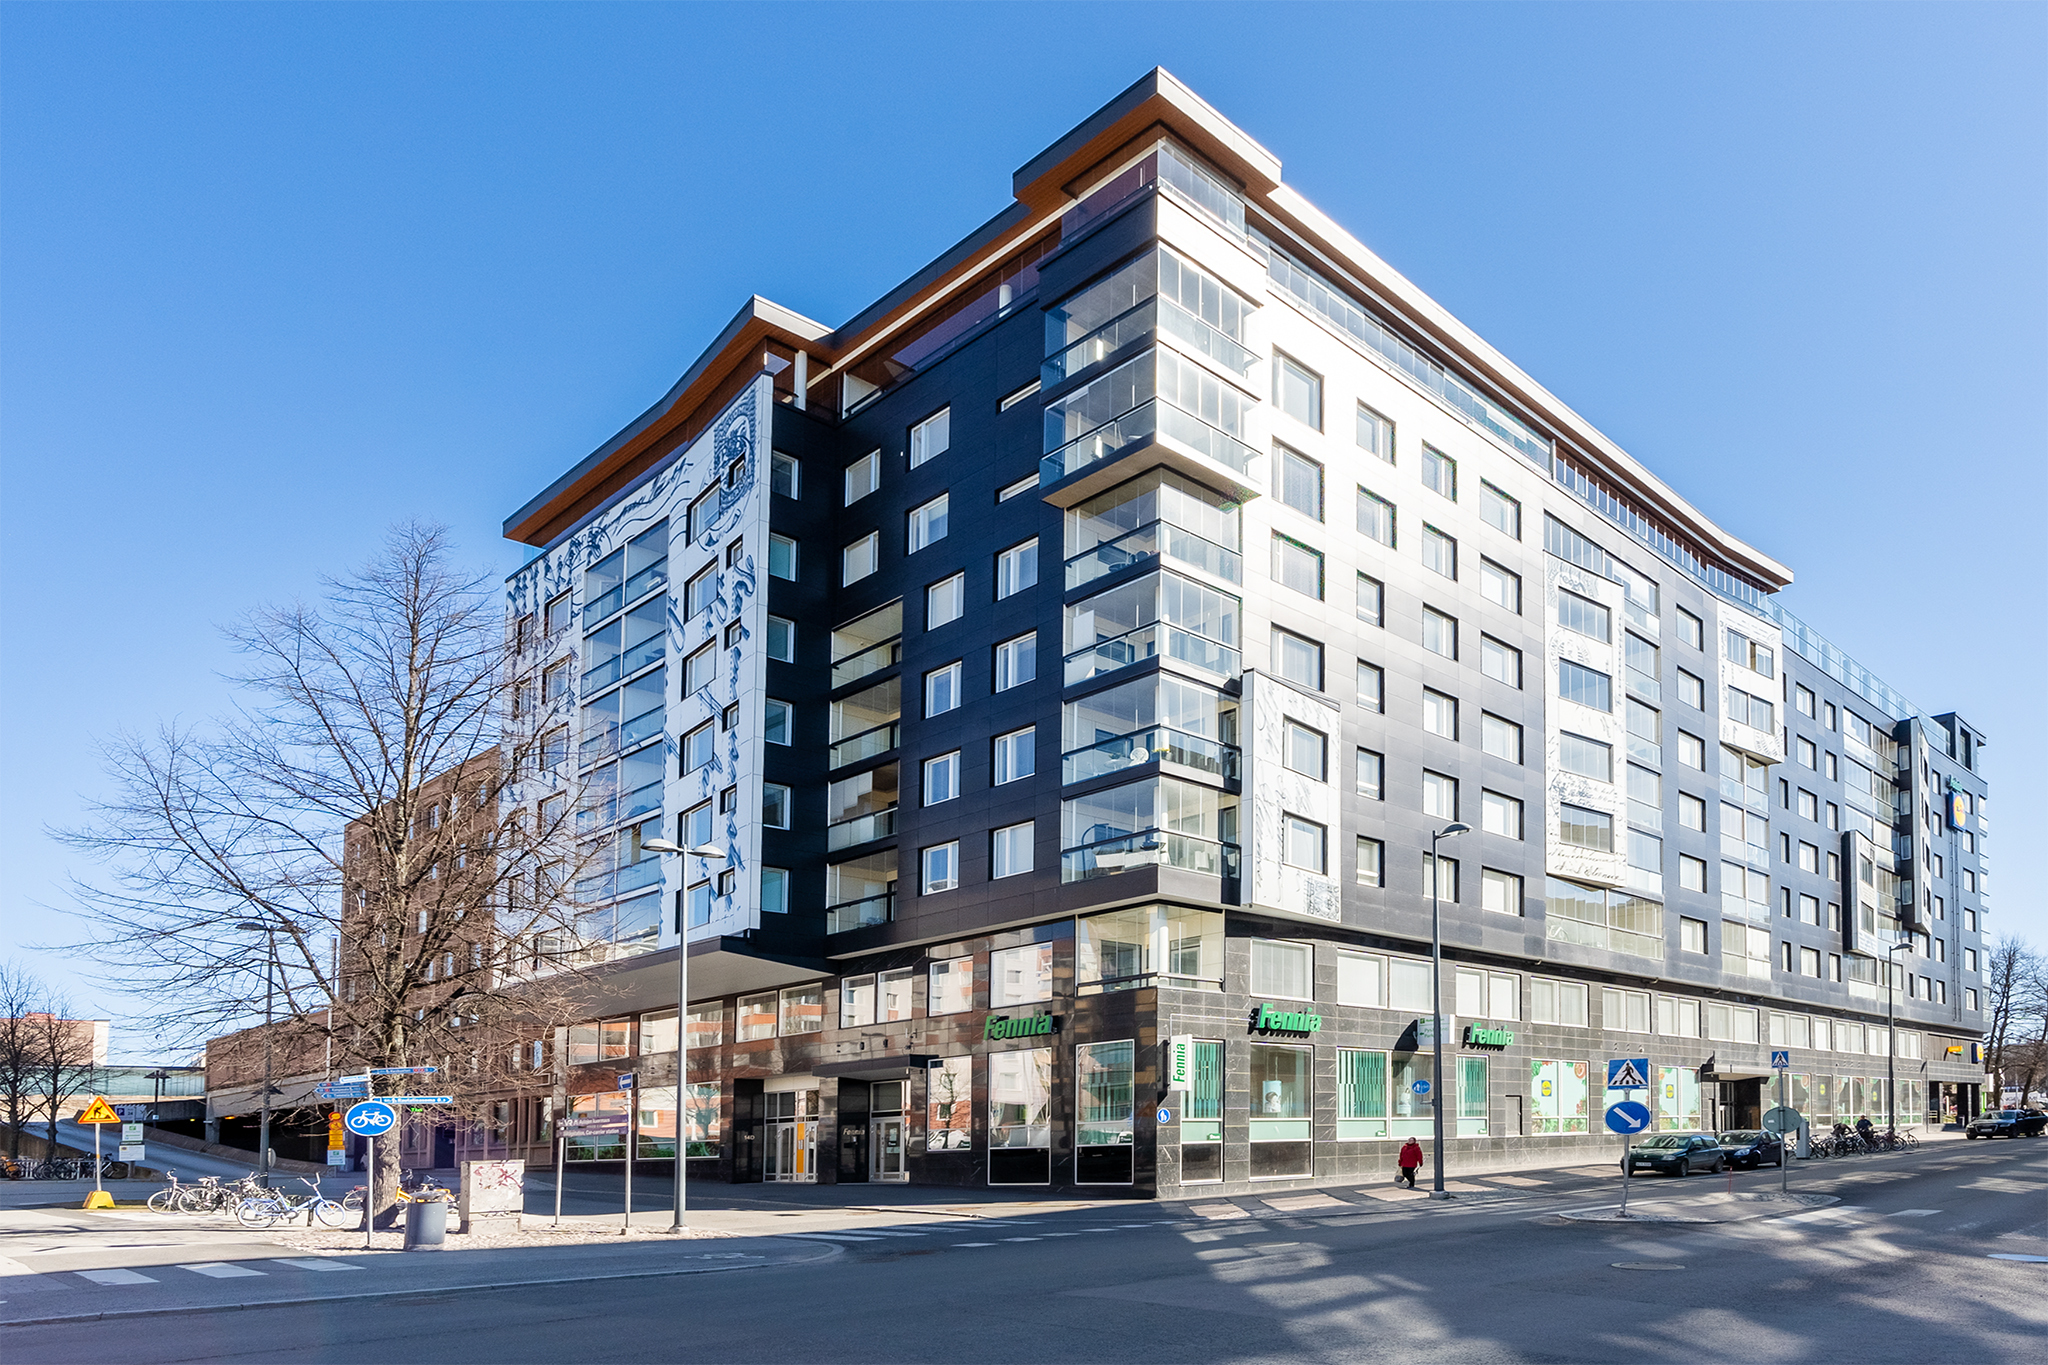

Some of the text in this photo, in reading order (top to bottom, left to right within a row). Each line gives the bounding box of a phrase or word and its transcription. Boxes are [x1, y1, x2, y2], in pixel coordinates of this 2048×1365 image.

[983, 1014, 1053, 1041] Fennia
[1260, 1002, 1322, 1032] Fennia
[1471, 1022, 1515, 1046] Fennia
[1173, 1043, 1186, 1083] Fennia
